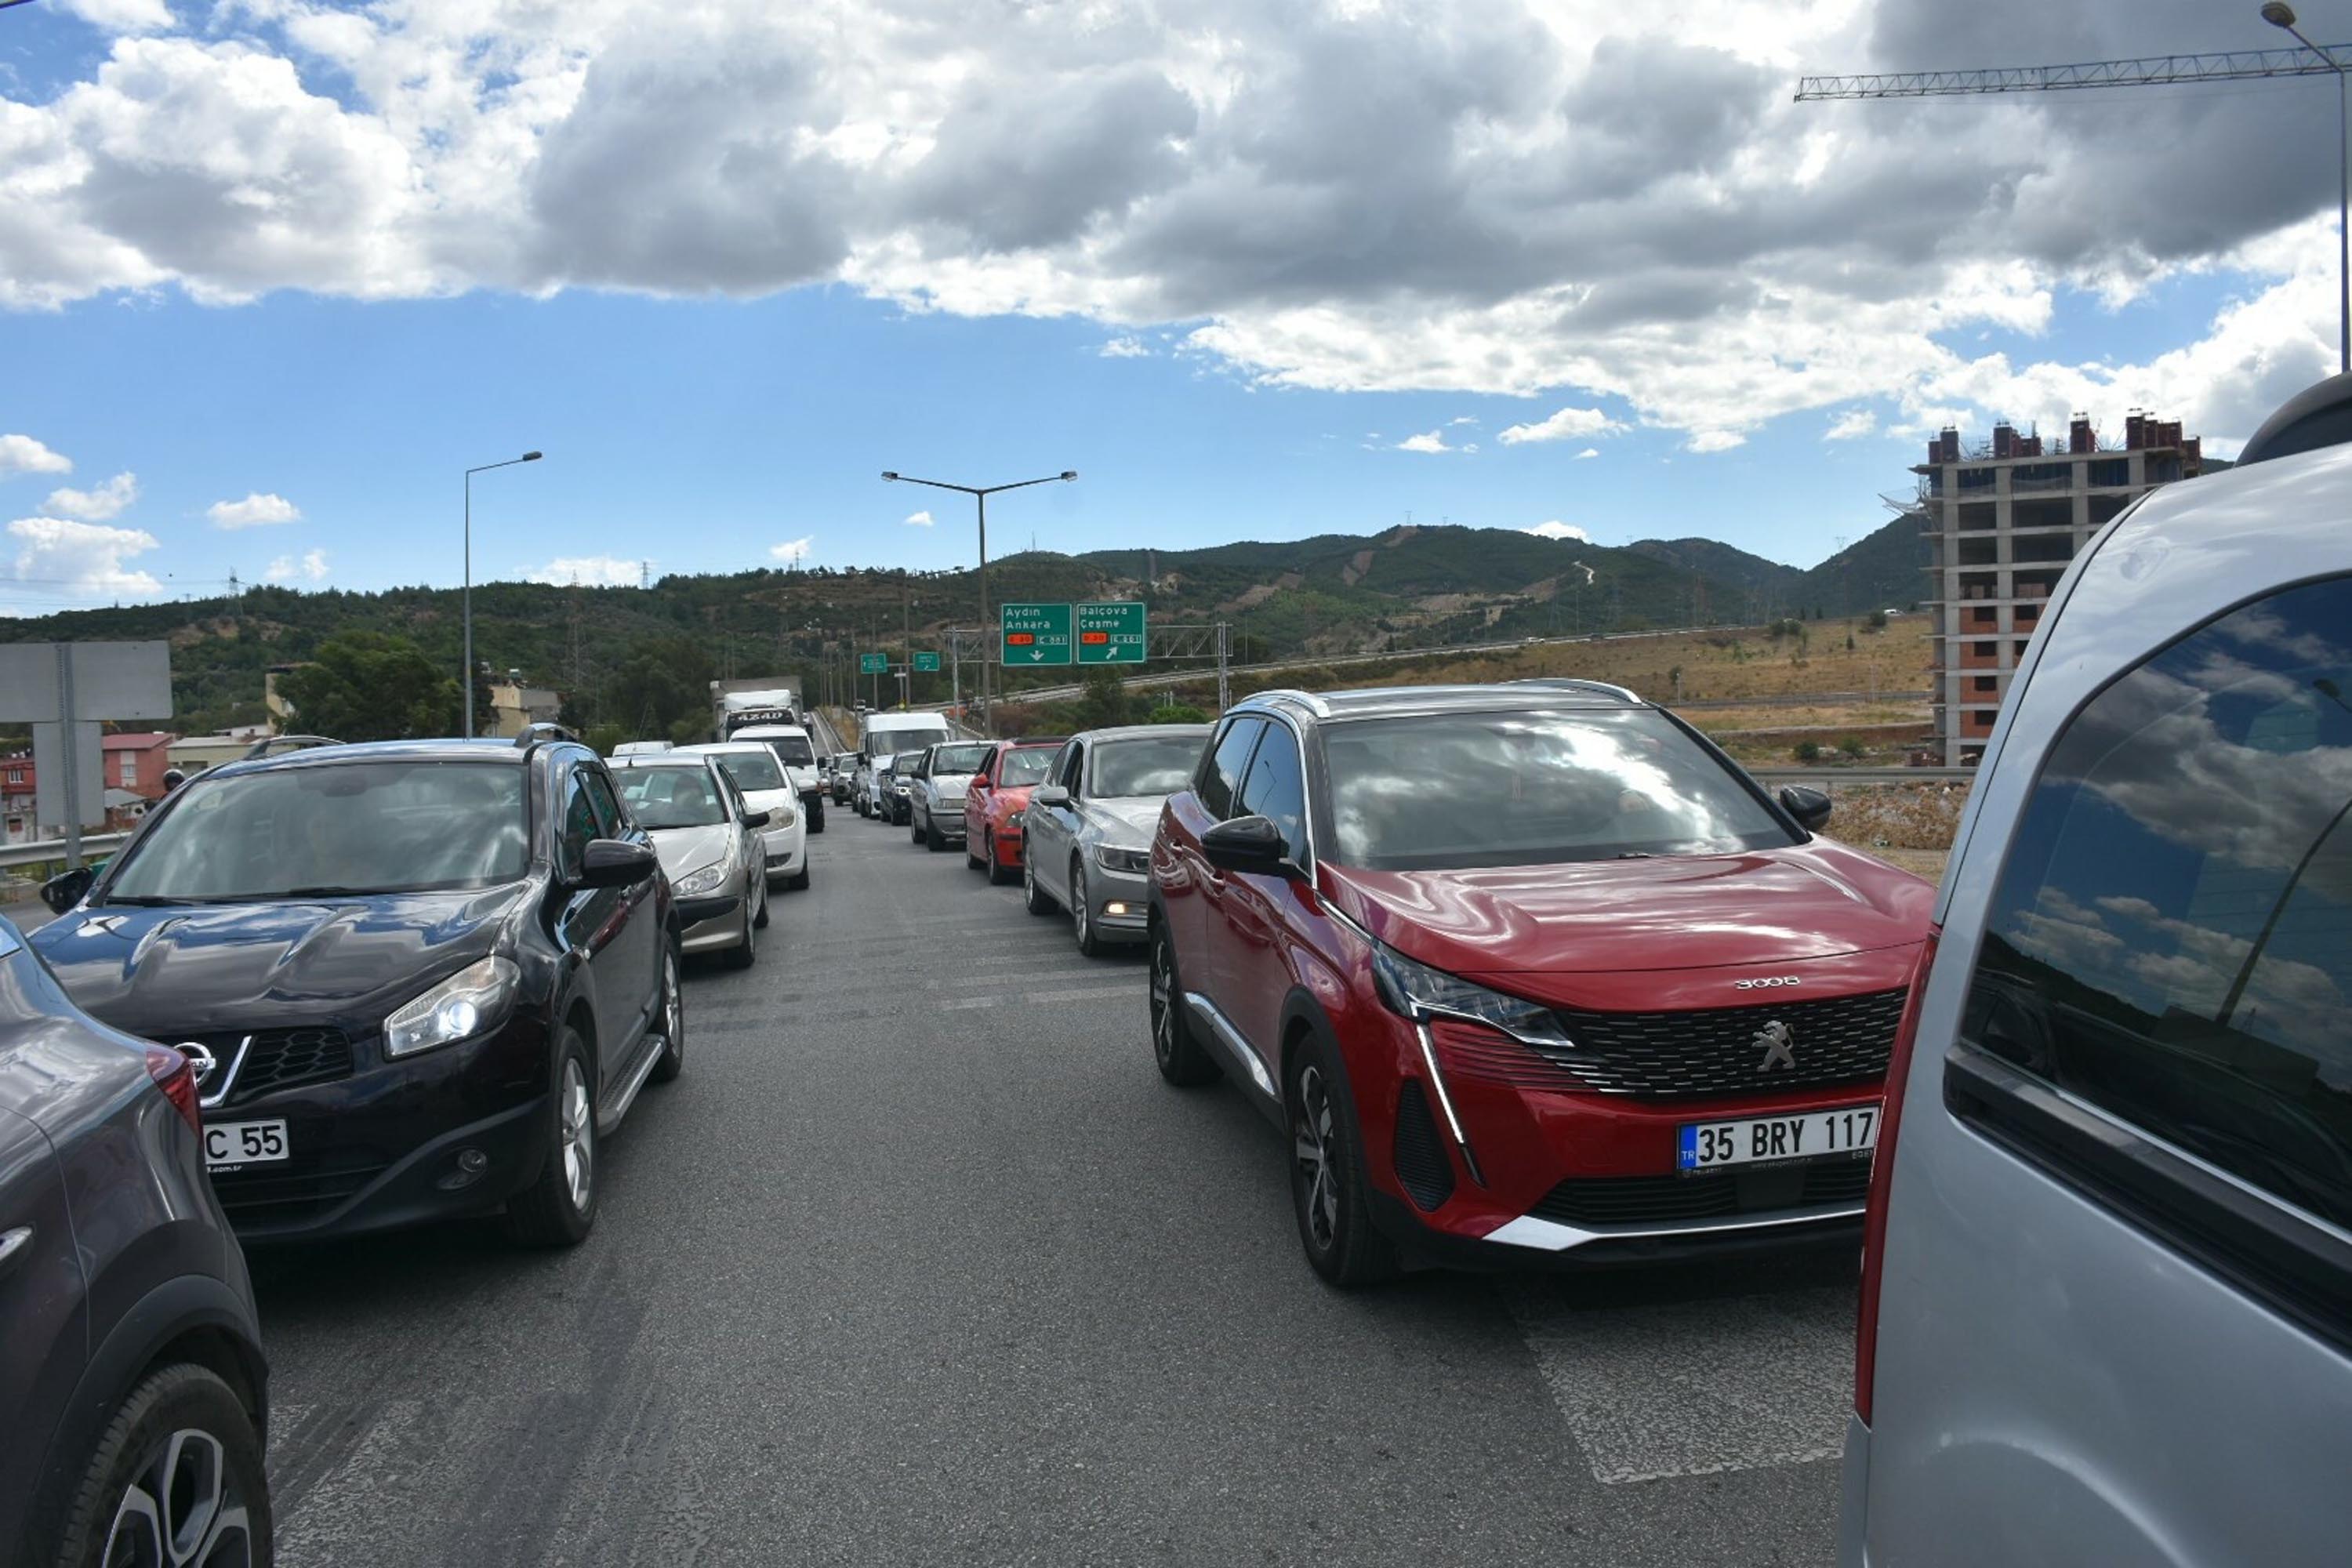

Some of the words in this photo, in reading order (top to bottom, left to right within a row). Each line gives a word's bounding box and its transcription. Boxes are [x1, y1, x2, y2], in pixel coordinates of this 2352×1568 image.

[1005, 608, 1040, 619] Aydın
[1080, 606, 1127, 616] Balçova
[1005, 620, 1051, 630] Ankara
[1080, 619, 1120, 630] Çeşme
[1734, 975, 1801, 989] 3008
[205, 1130, 228, 1159] C
[241, 1124, 282, 1156] 55
[1699, 1127, 1734, 1162] 35
[1751, 1119, 1805, 1157] BRY
[1825, 1112, 1873, 1149] 117
[1681, 1150, 1696, 1160] TR
